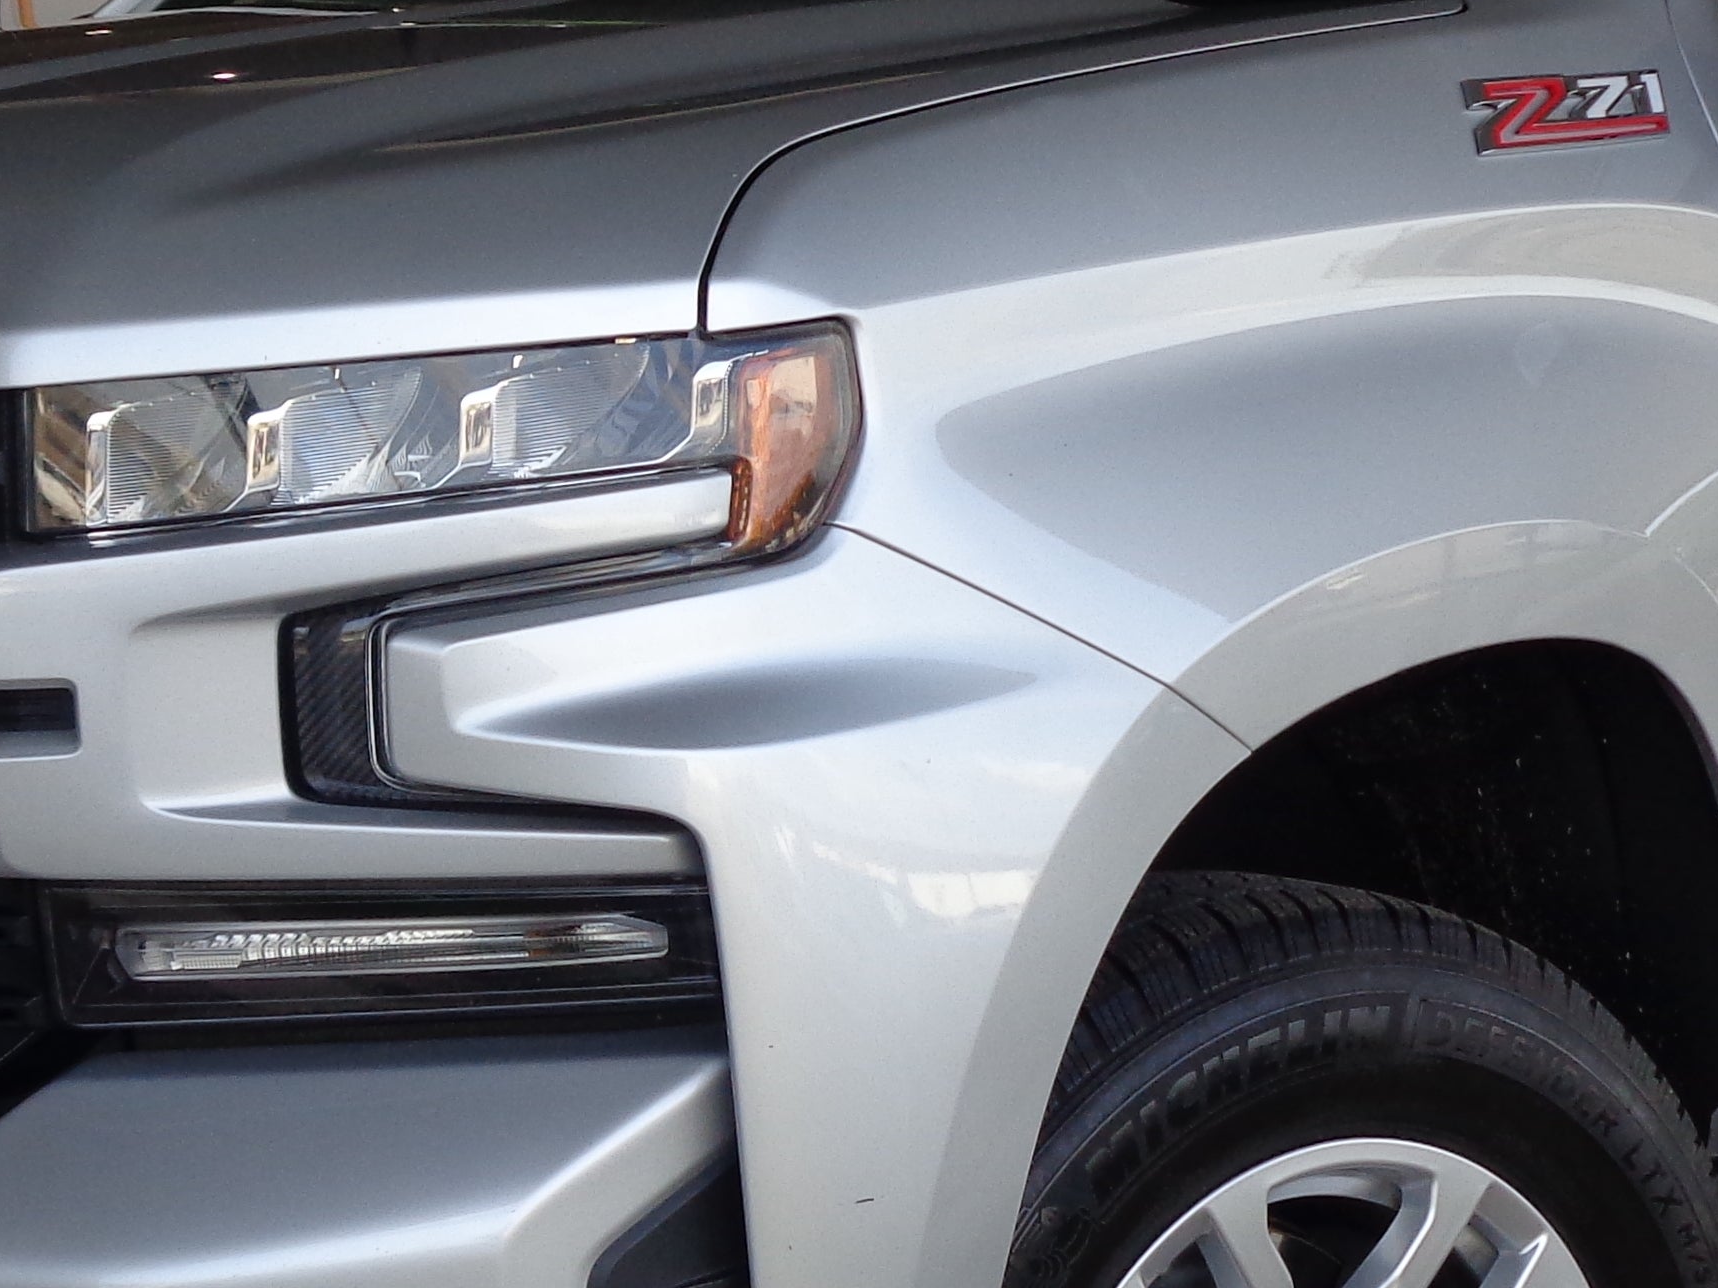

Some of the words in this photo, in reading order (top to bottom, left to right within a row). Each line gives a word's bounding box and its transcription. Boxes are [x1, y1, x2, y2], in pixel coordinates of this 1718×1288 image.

[1459, 68, 1671, 158] Z71
[1083, 1004, 1392, 1203] MICHELIN
[1427, 1010, 1621, 1139] DEFENDER
